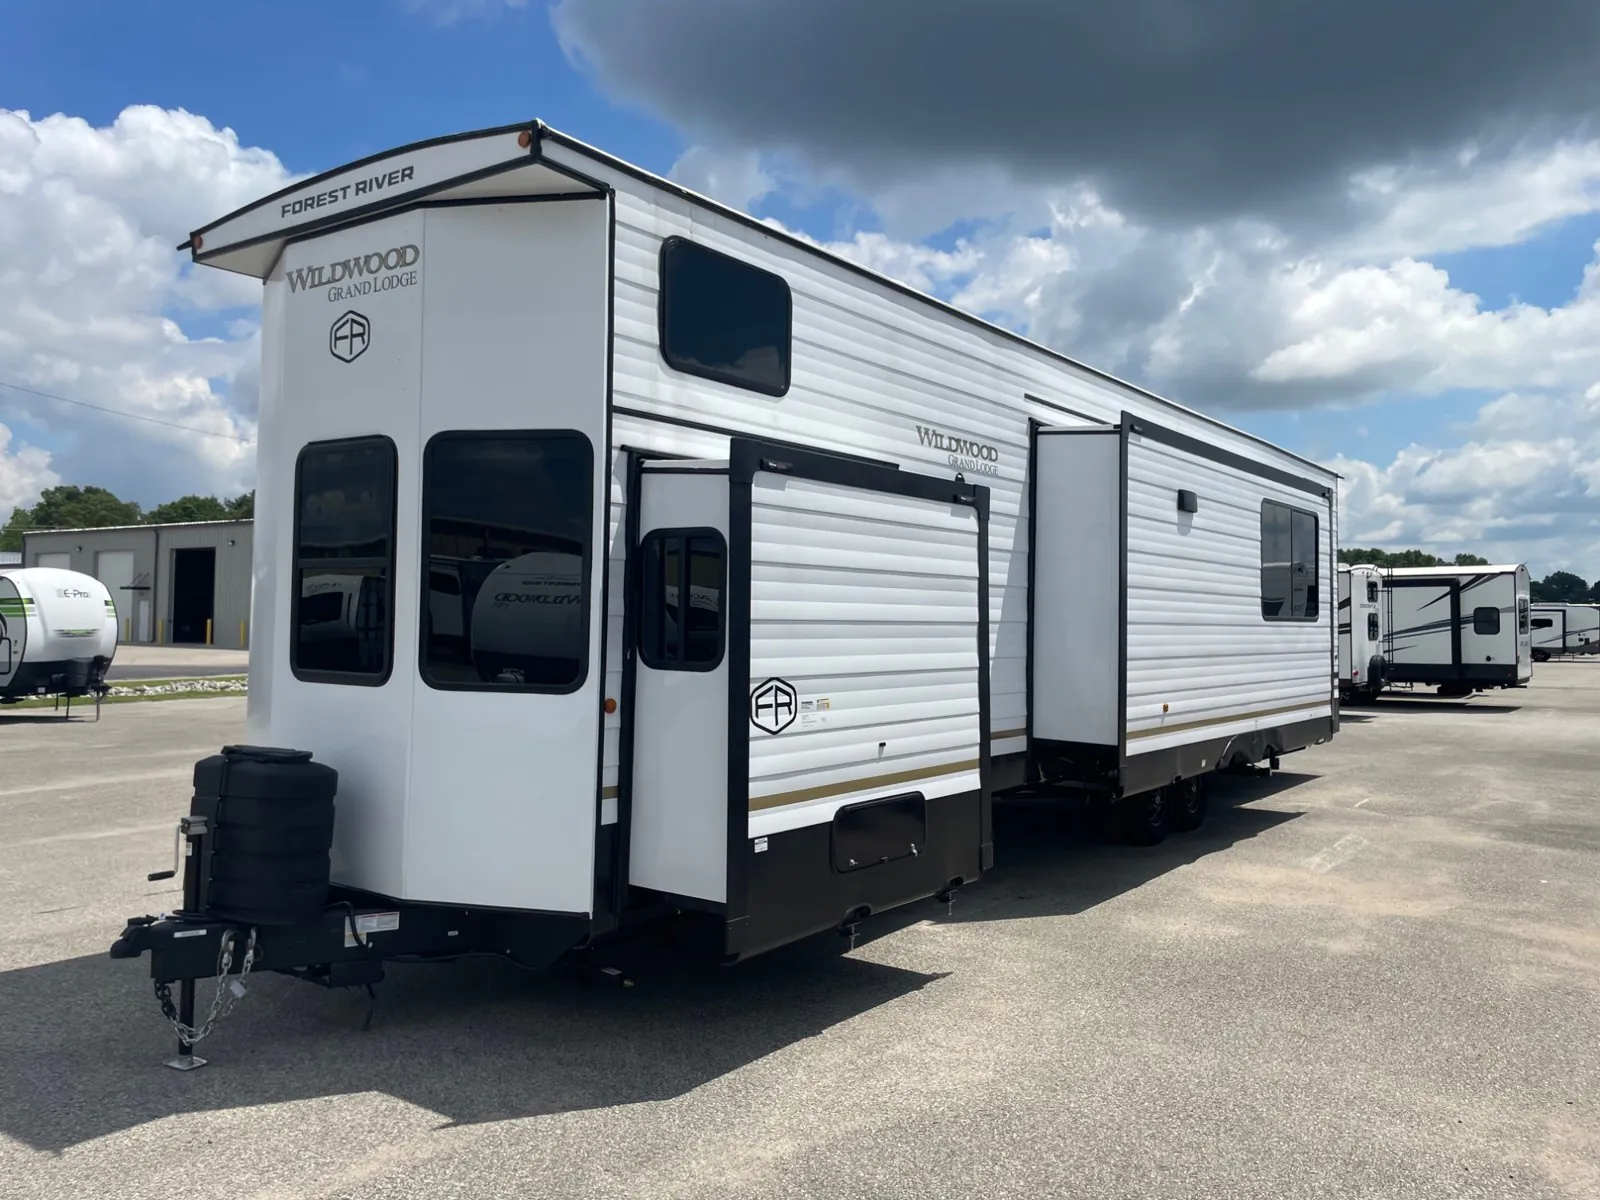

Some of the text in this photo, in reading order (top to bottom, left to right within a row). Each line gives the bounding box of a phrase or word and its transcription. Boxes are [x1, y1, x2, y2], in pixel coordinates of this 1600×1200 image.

[281, 165, 415, 218] FOREST RIVER
[286, 244, 420, 293] WILDWOOD
[328, 271, 418, 302] GRAND LODGE
[916, 425, 998, 462] WILDWOOD
[948, 454, 999, 476] GRAND LODGE
